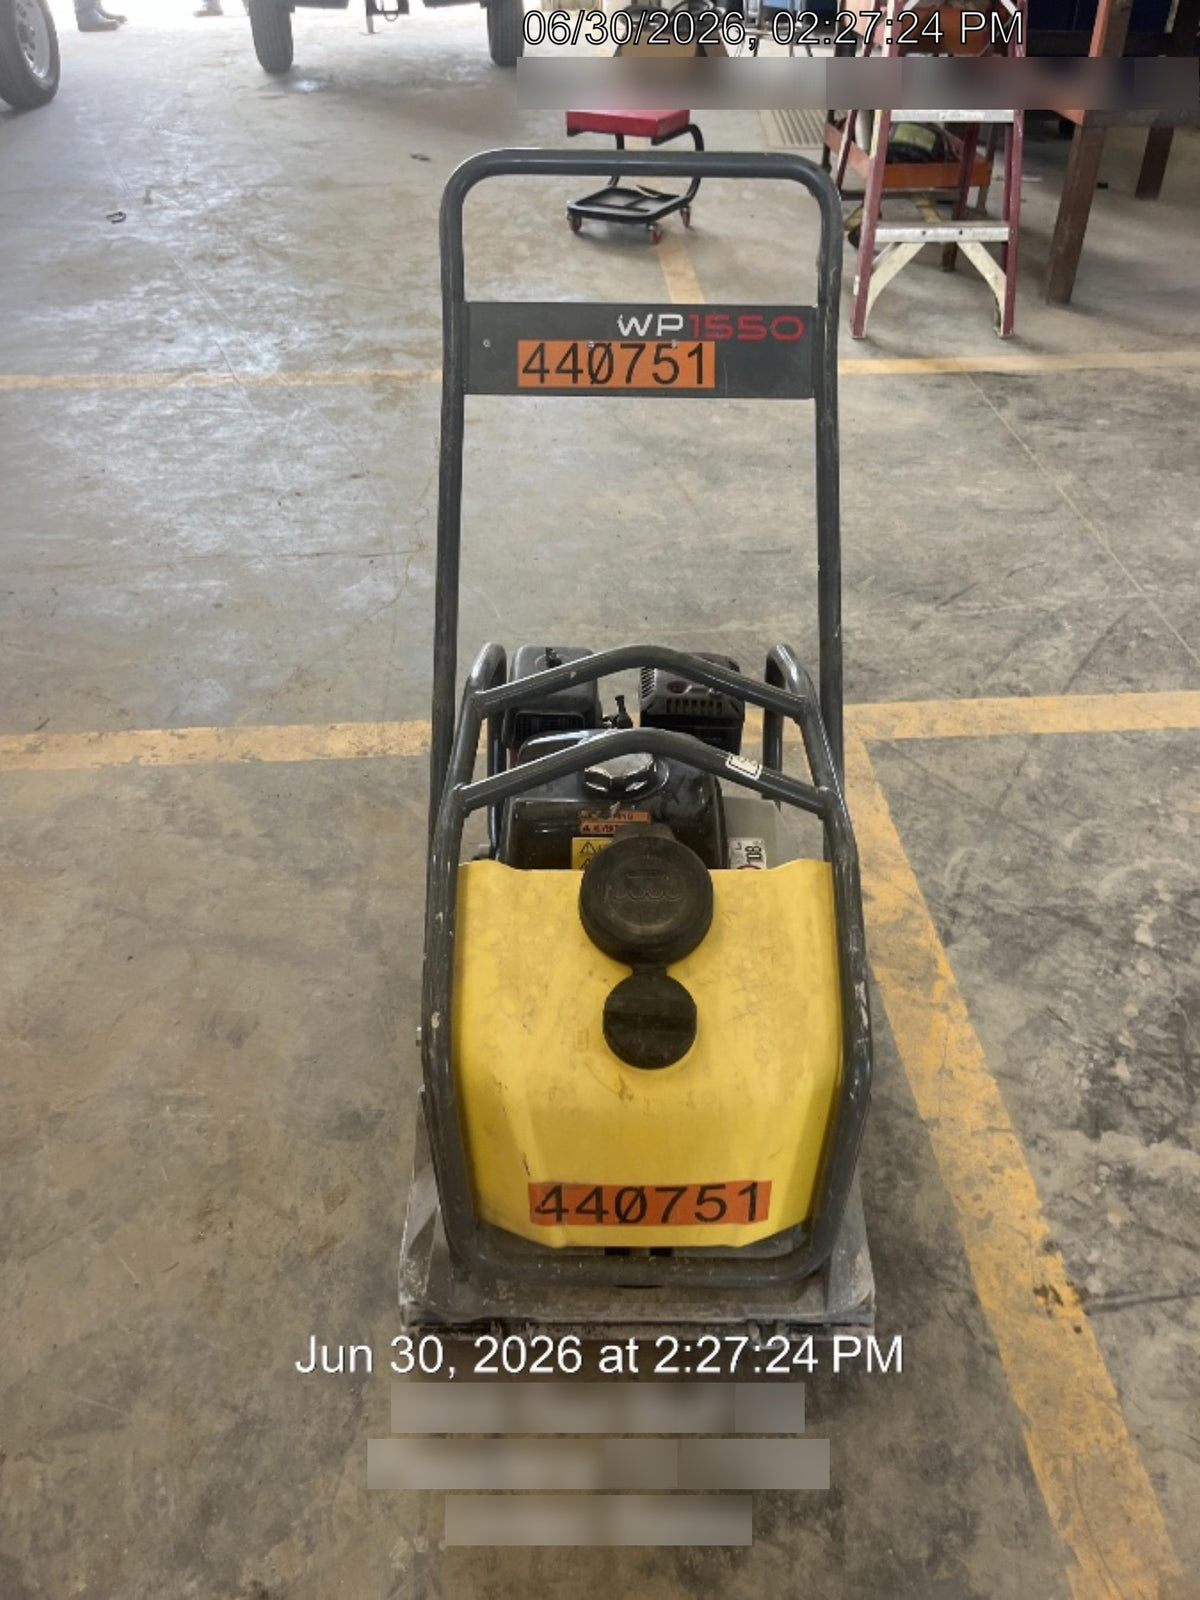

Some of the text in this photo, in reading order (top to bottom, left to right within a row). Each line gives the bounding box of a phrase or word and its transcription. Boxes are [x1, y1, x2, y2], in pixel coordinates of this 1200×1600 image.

[616, 313, 805, 341] WP1550
[521, 341, 706, 385] 440751
[534, 1181, 758, 1224] 440751
